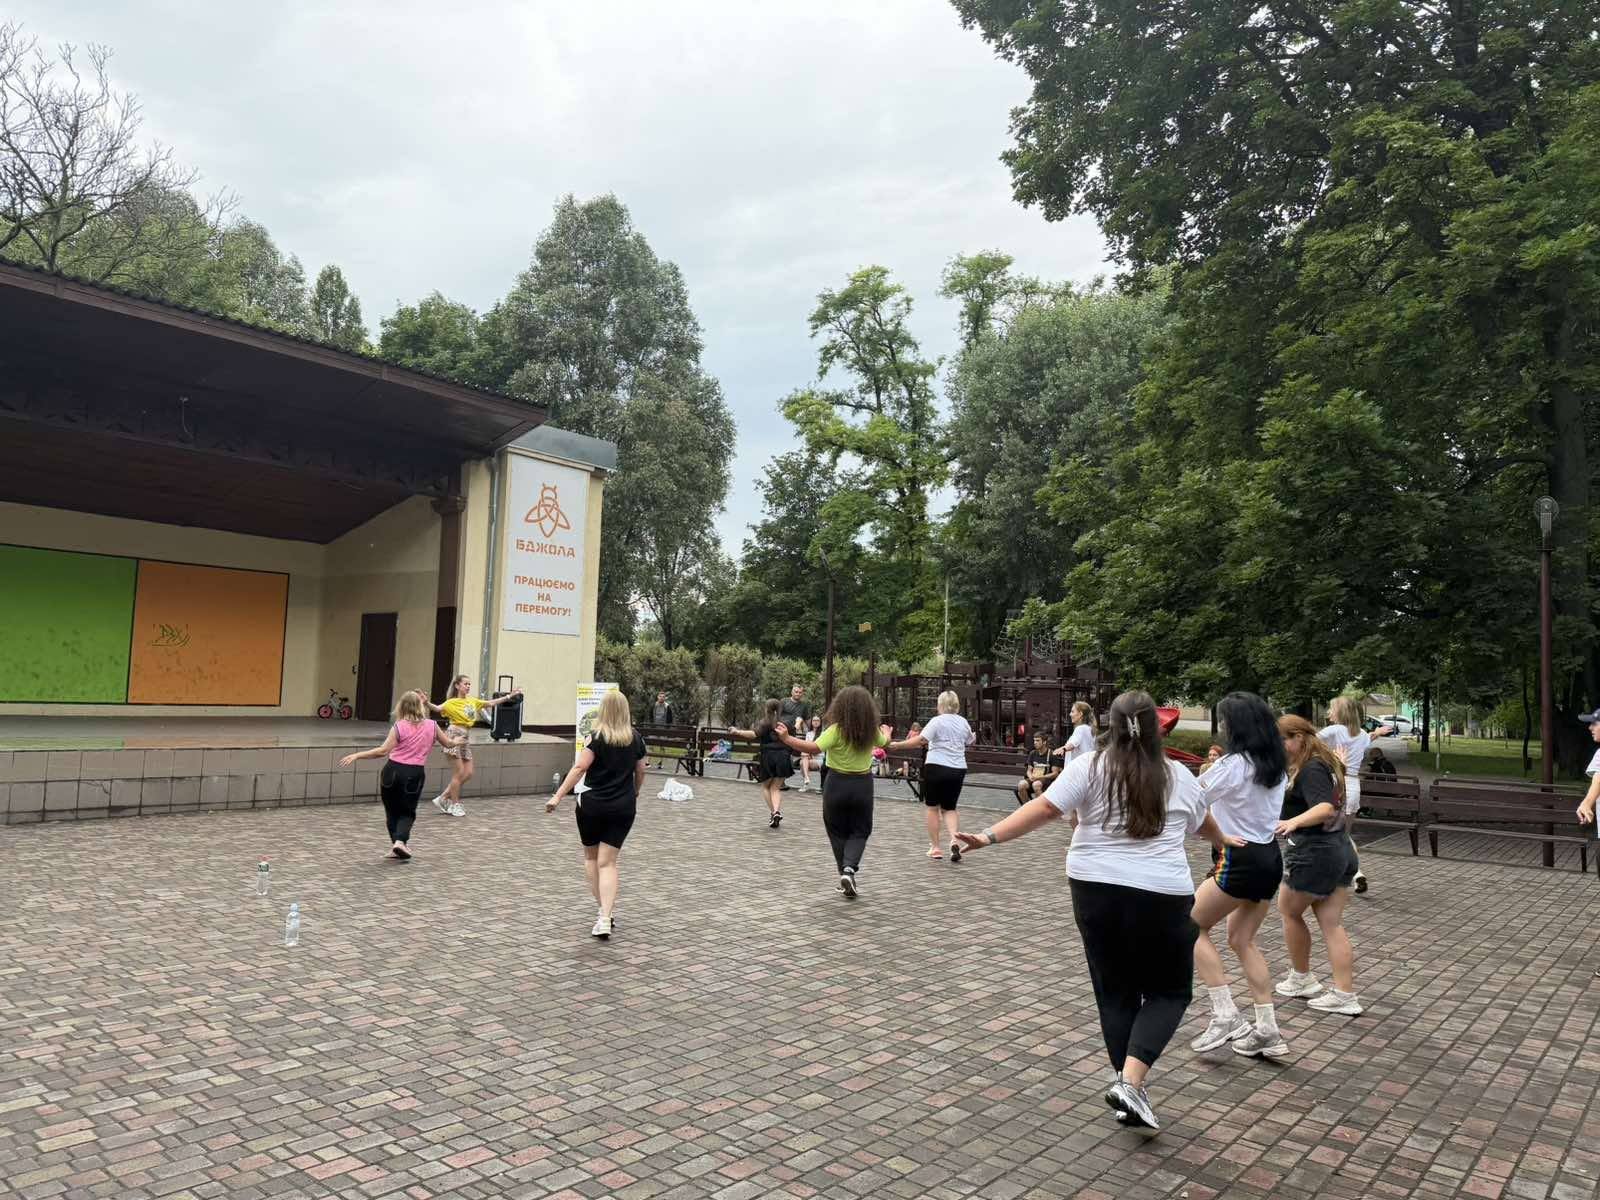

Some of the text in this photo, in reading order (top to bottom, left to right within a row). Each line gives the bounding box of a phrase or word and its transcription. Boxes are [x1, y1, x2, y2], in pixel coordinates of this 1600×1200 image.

[516, 539, 575, 557] БДЖОЛА
[514, 576, 575, 591] ПРАЦЮЄМО
[537, 593, 551, 602] НА
[515, 604, 571, 616] ПЕРЕМОГУ!
